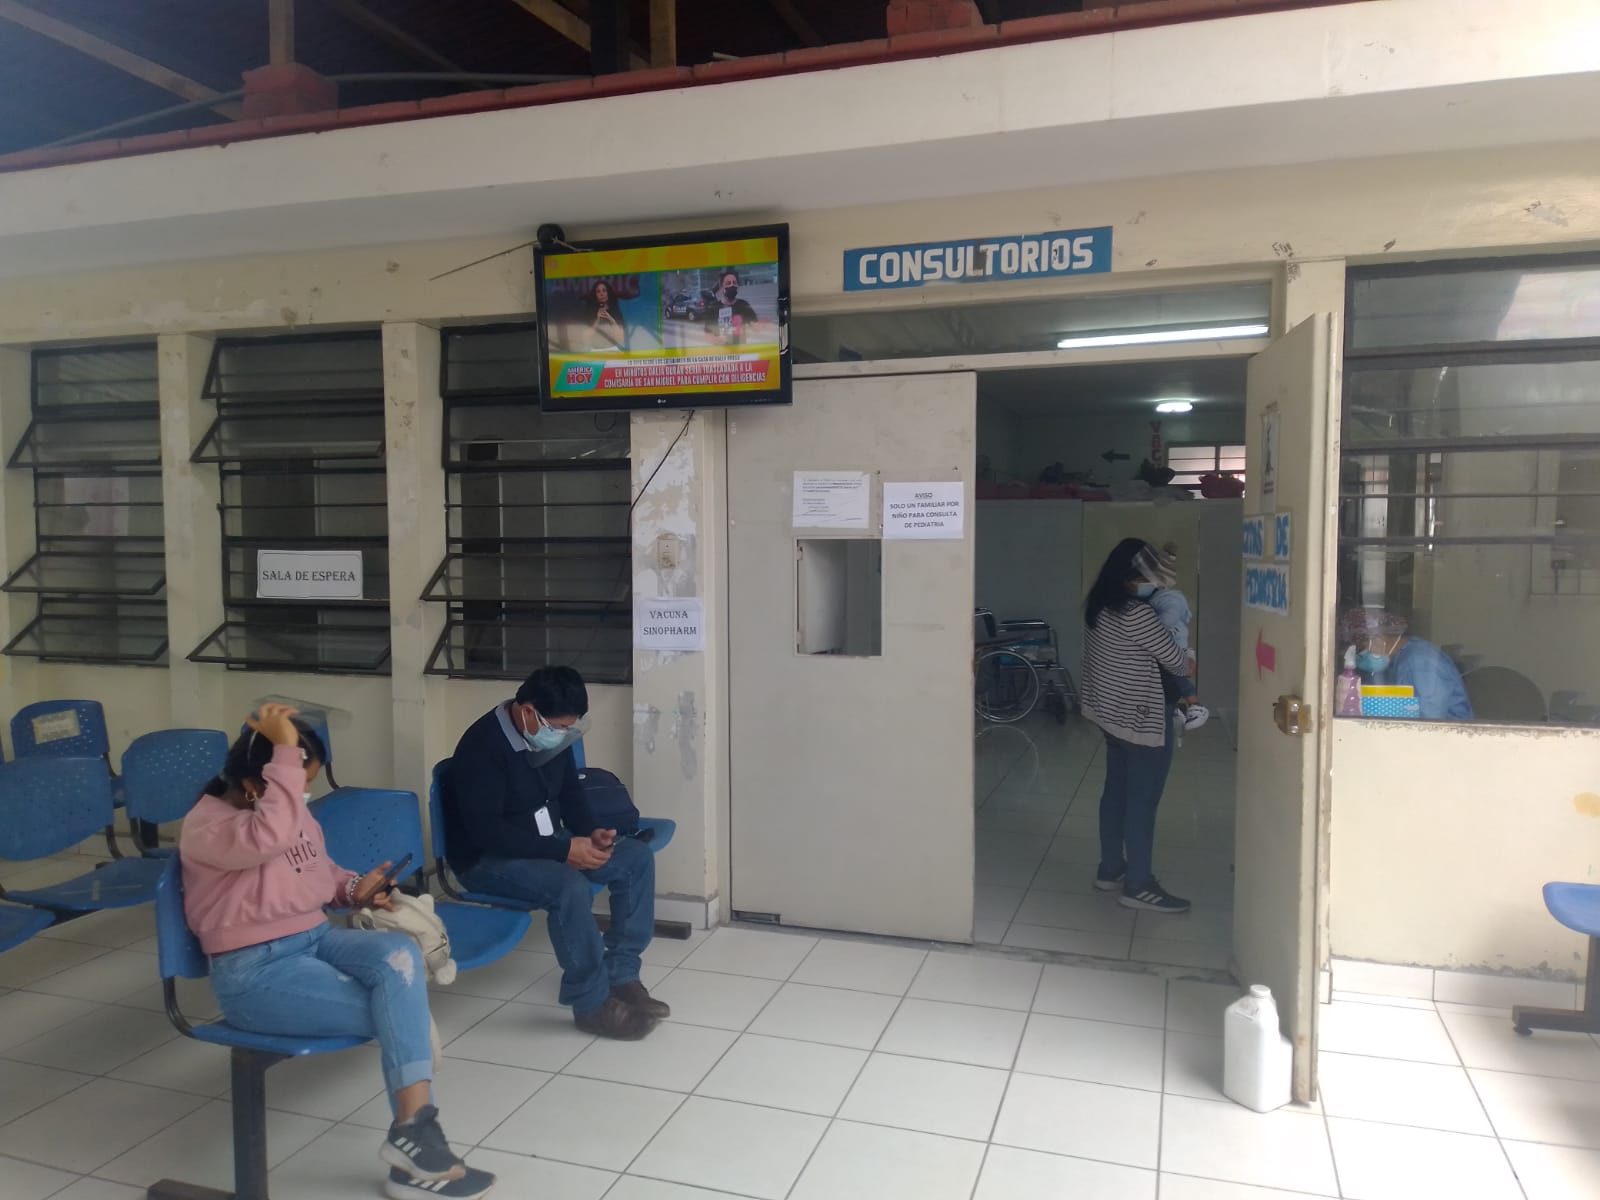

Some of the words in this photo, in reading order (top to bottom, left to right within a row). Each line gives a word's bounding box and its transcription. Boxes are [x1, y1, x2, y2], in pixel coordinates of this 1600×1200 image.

[859, 235, 1094, 285] CONSULTORIOS
[566, 373, 592, 384] HOY
[262, 570, 291, 580] SALA
[295, 571, 309, 580] DE
[312, 571, 355, 581] ESPERA
[649, 610, 688, 619] VACUNA
[643, 626, 697, 635] SINOPHARM
